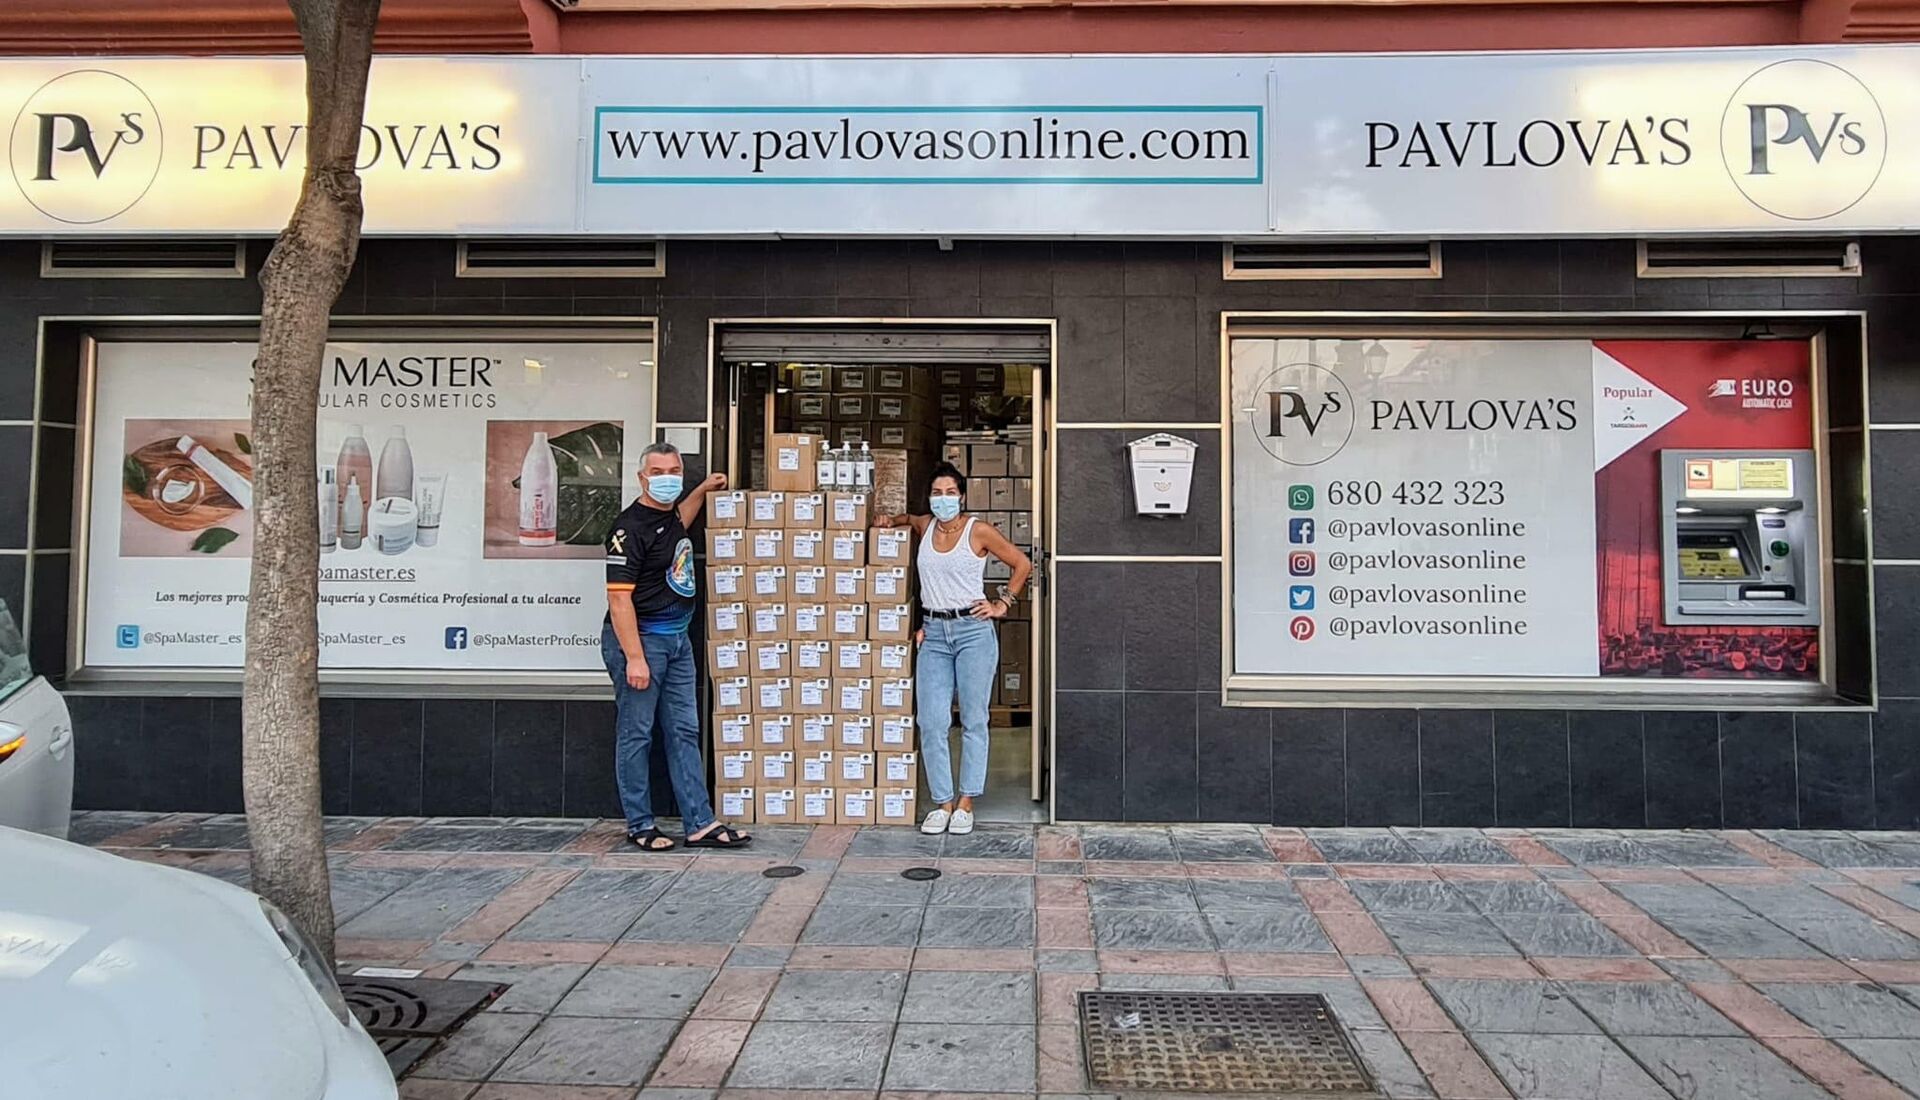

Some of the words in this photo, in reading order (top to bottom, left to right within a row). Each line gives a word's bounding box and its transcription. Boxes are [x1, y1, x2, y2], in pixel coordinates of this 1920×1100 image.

[194, 124, 502, 170] PAVOVA'S
[606, 117, 1251, 173] www.pavlovasonline.com
[1364, 115, 1692, 168] PAVLOVA'S
[333, 356, 492, 387] MASTER
[1603, 386, 1653, 400] Popular
[1741, 379, 1793, 396] EURO
[380, 393, 497, 408] COSMETICS
[1371, 399, 1577, 431] PAVLOVA'S
[1327, 481, 1382, 505] 680
[1391, 481, 1444, 505] 432
[1453, 481, 1505, 505] 323
[1328, 517, 1526, 540] @pavlovasonline
[1328, 548, 1526, 573] @pavlovasonline
[319, 567, 416, 580] amaster.es
[155, 591, 175, 602] Los
[178, 591, 222, 605] mejores
[320, 593, 365, 606] uquería
[368, 596, 376, 606] y
[379, 592, 439, 605] Cosmética
[443, 593, 508, 606] Profesional
[522, 595, 535, 604] tu
[538, 594, 581, 605] alcance
[1328, 583, 1527, 607] @pavlovasonline
[1329, 614, 1527, 639] @pavlovasonline
[144, 632, 242, 645] @SpaMaster_es
[318, 632, 406, 647] SpaMaster_es
[473, 634, 600, 647] @SpaMasterProfesio
